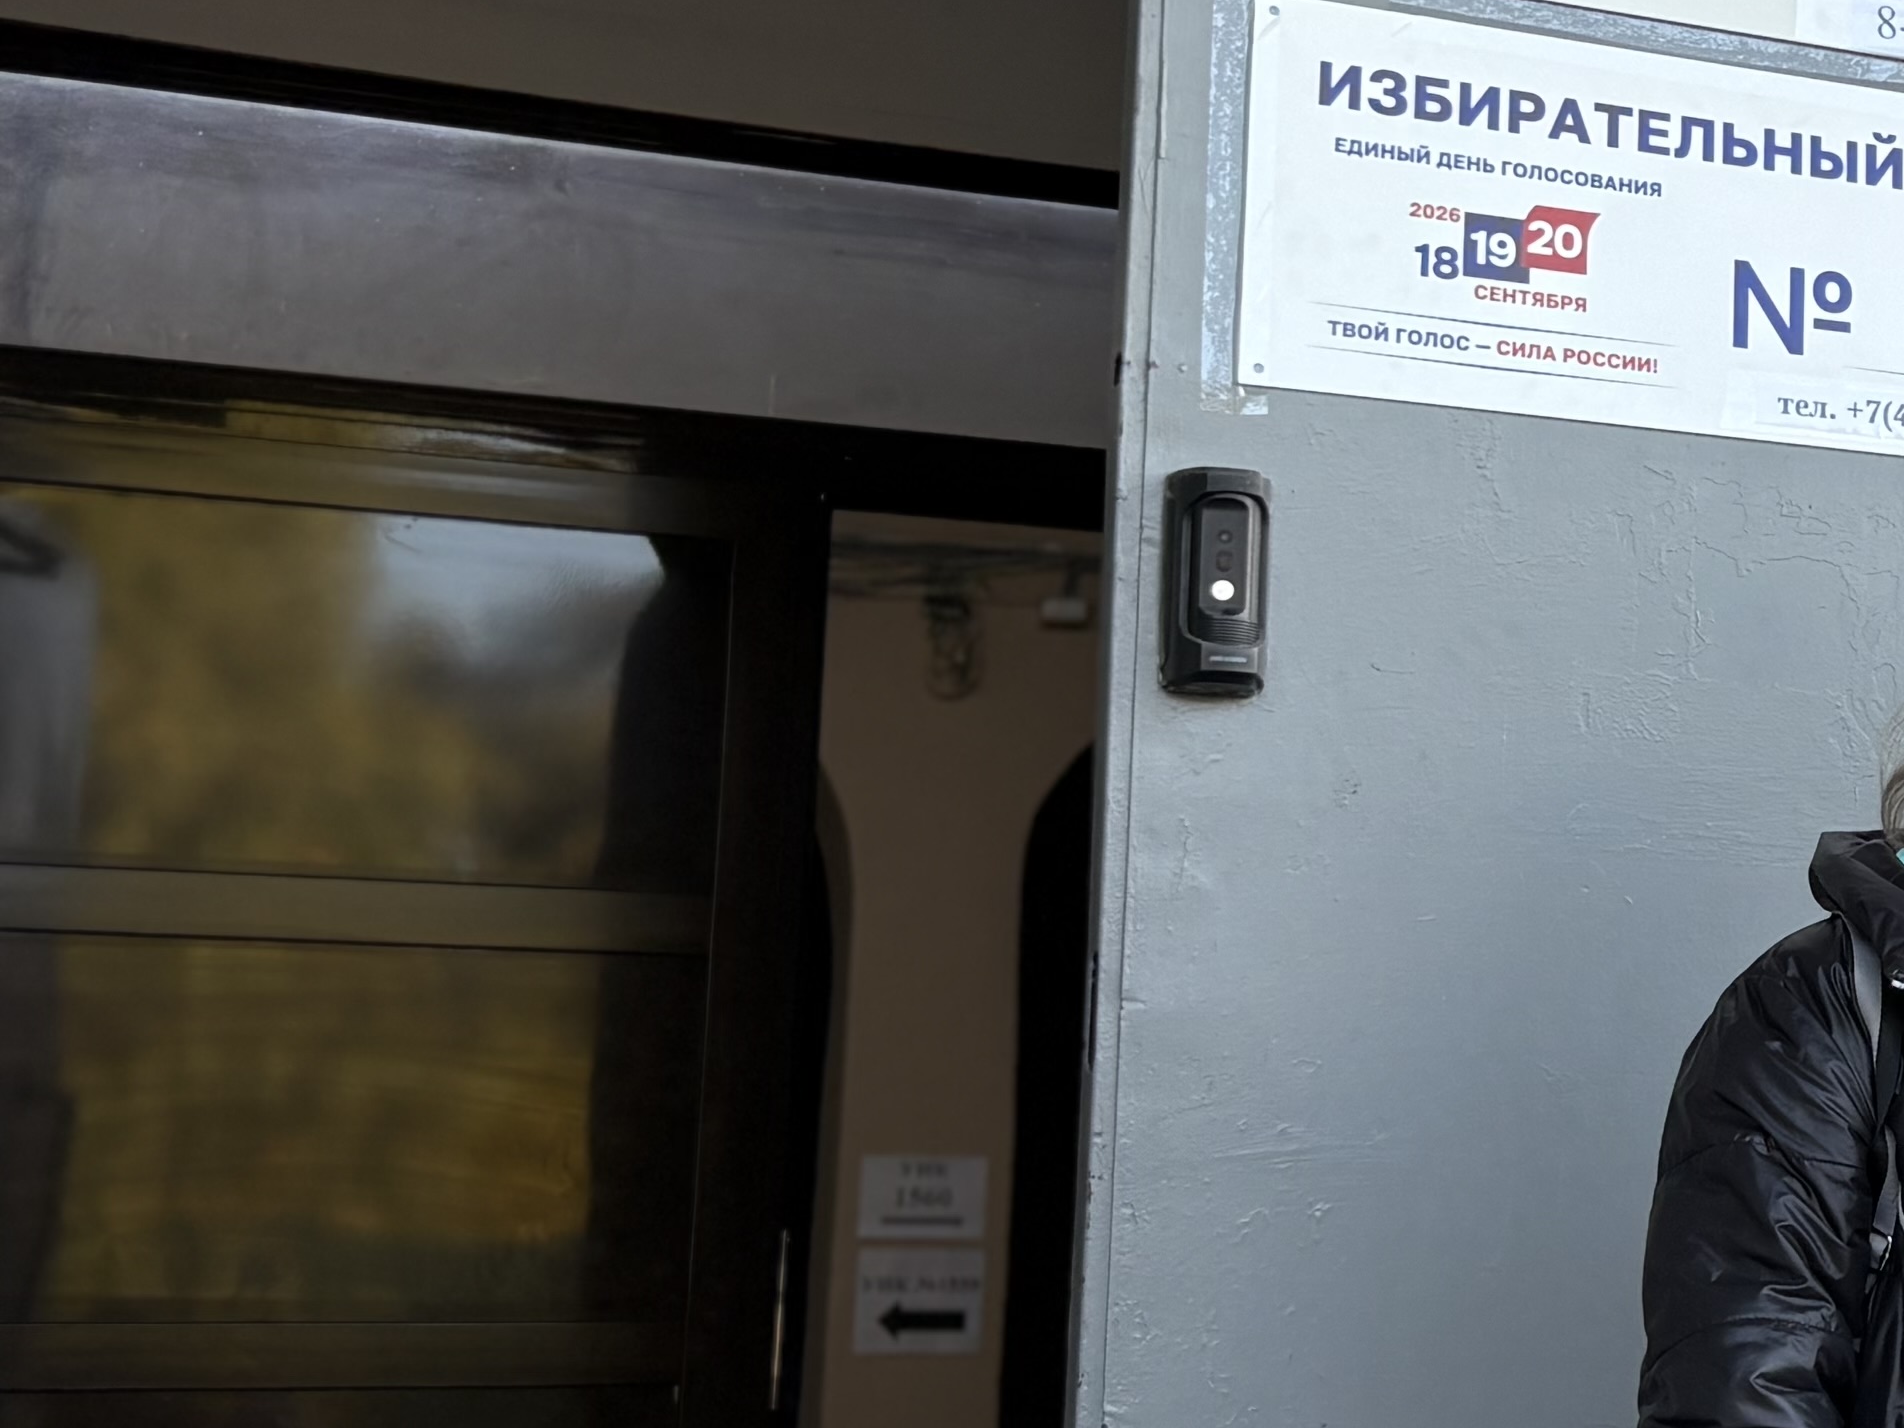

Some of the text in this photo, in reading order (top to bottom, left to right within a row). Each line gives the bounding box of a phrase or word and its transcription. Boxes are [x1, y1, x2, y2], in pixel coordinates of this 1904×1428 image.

[1318, 61, 1903, 190] ИЗБИРАТЕЛЬНЫЙ
[1334, 137, 1663, 198] ЕДИНЫЙ ДЕНЬ ГОЛОСОВАНИЯ
[1409, 202, 1461, 223] 2026
[1414, 220, 1583, 280] 18 19 20
[1473, 285, 1587, 313] СЕНТЯБРЯ
[1732, 259, 1853, 356] №
[1327, 320, 1389, 342] ТВОЙ
[1395, 328, 1470, 352] ГОЛОС
[1496, 339, 1556, 362] СИЛА
[1562, 348, 1658, 374] РОССИИ!
[1777, 395, 1837, 421] тел.
